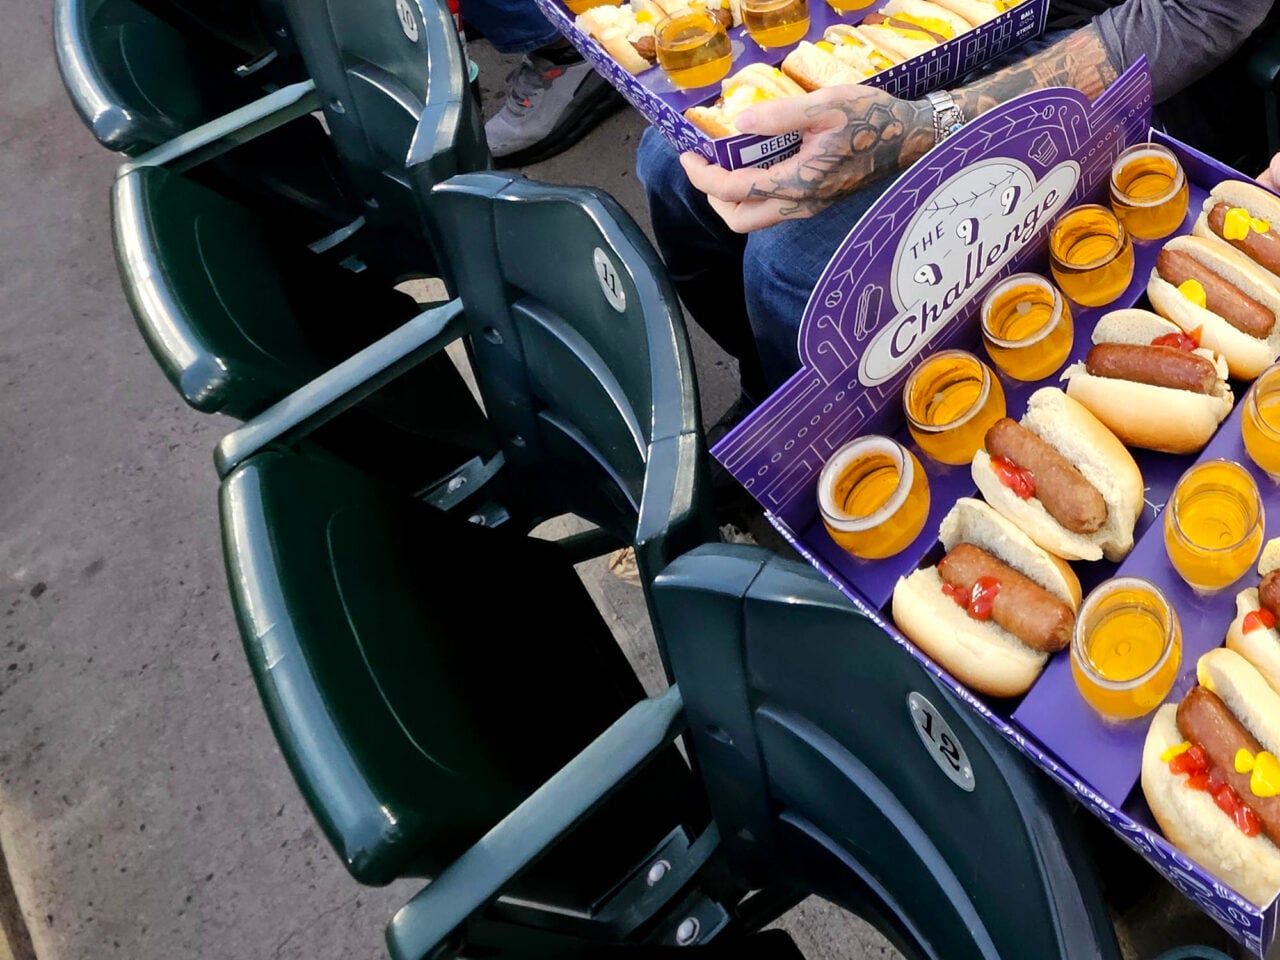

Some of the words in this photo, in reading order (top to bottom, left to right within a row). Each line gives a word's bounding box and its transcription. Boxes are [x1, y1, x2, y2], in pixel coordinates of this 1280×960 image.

[400, 3, 414, 31] 10
[760, 130, 800, 155] BEERS
[910, 221, 946, 259] THE
[602, 263, 618, 298] 11
[889, 189, 1060, 359] Challenge
[922, 709, 960, 772] 12
